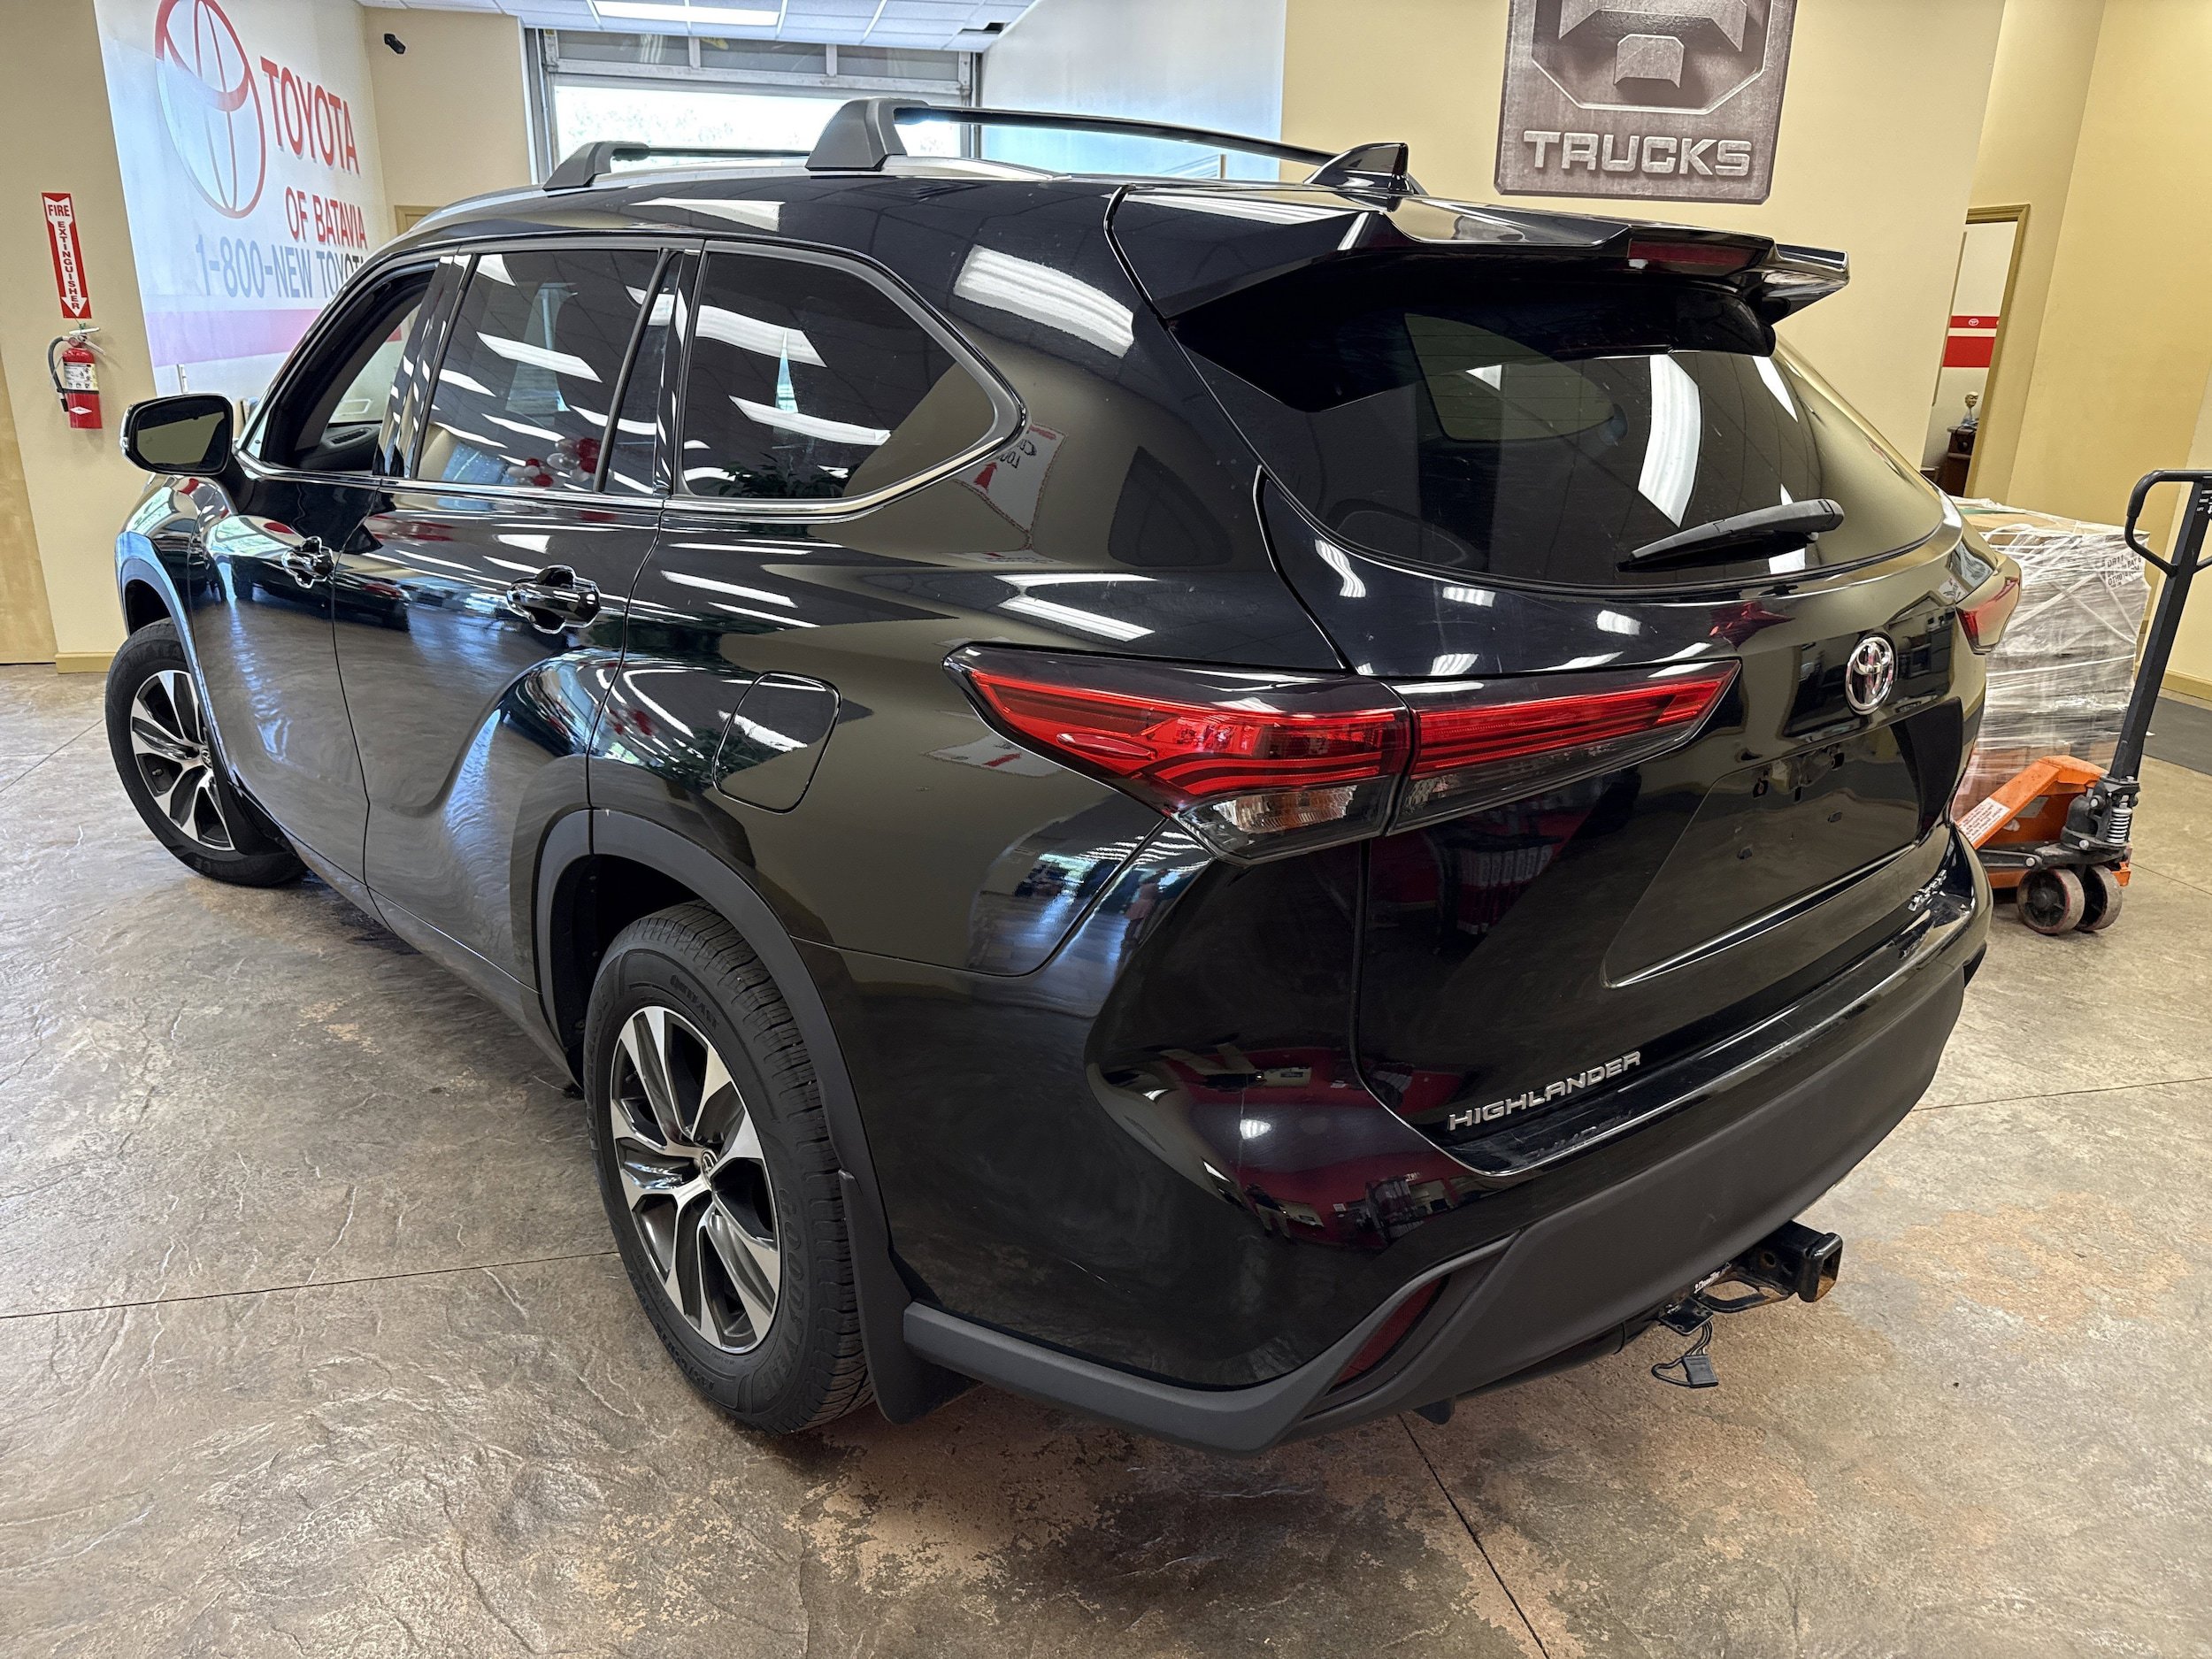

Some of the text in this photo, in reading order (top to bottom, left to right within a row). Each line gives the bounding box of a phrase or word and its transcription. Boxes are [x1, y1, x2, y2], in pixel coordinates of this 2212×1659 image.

[260, 56, 359, 175] TOYOTA
[1523, 130, 1753, 177] TRUCKS
[48, 204, 71, 217] FIRE
[285, 186, 368, 250] OF BATAVIA
[58, 220, 80, 310] EXTINGUISHER
[196, 234, 364, 298] 1-800-NEW TOYO
[1448, 1050, 1641, 1132] HIGHLANDER
